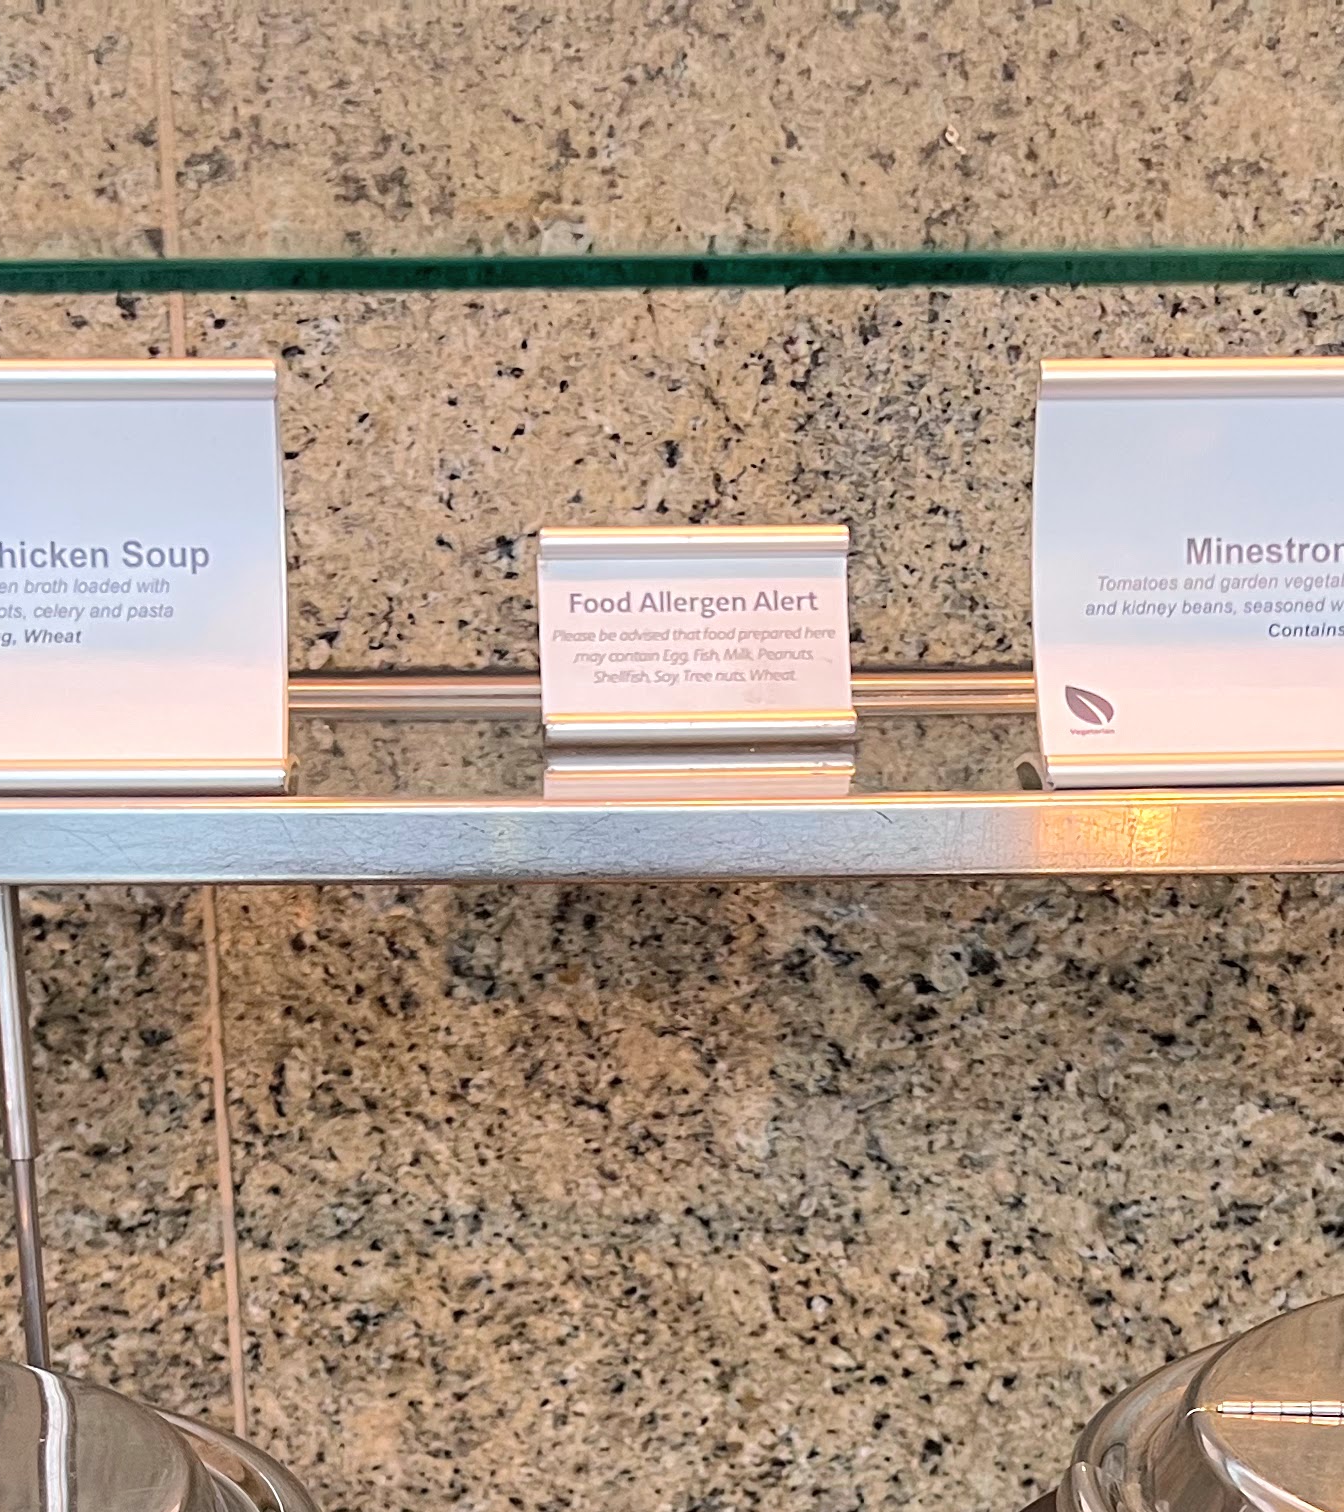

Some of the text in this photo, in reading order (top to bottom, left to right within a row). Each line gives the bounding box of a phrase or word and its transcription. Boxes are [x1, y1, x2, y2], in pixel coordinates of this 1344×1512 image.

[121, 540, 210, 575] Soup
[23, 578, 69, 594] broth
[72, 577, 132, 594] loaded
[136, 577, 171, 594] with
[1097, 574, 1179, 592] Tomatoes
[1183, 573, 1216, 591] and
[1219, 573, 1279, 594] garden
[32, 603, 86, 623] celery
[89, 603, 123, 619] and
[126, 603, 175, 623] pasta
[569, 590, 819, 618] Food Allergen Alert
[1084, 599, 1118, 617] and
[1121, 599, 1178, 620] kidney
[1181, 598, 1238, 617] beans,
[1242, 596, 1327, 614] seasoned
[23, 628, 83, 645] Wheat
[552, 626, 836, 643] Please be advised that food prepared here
[573, 652, 607, 666] may
[608, 651, 661, 663] contain
